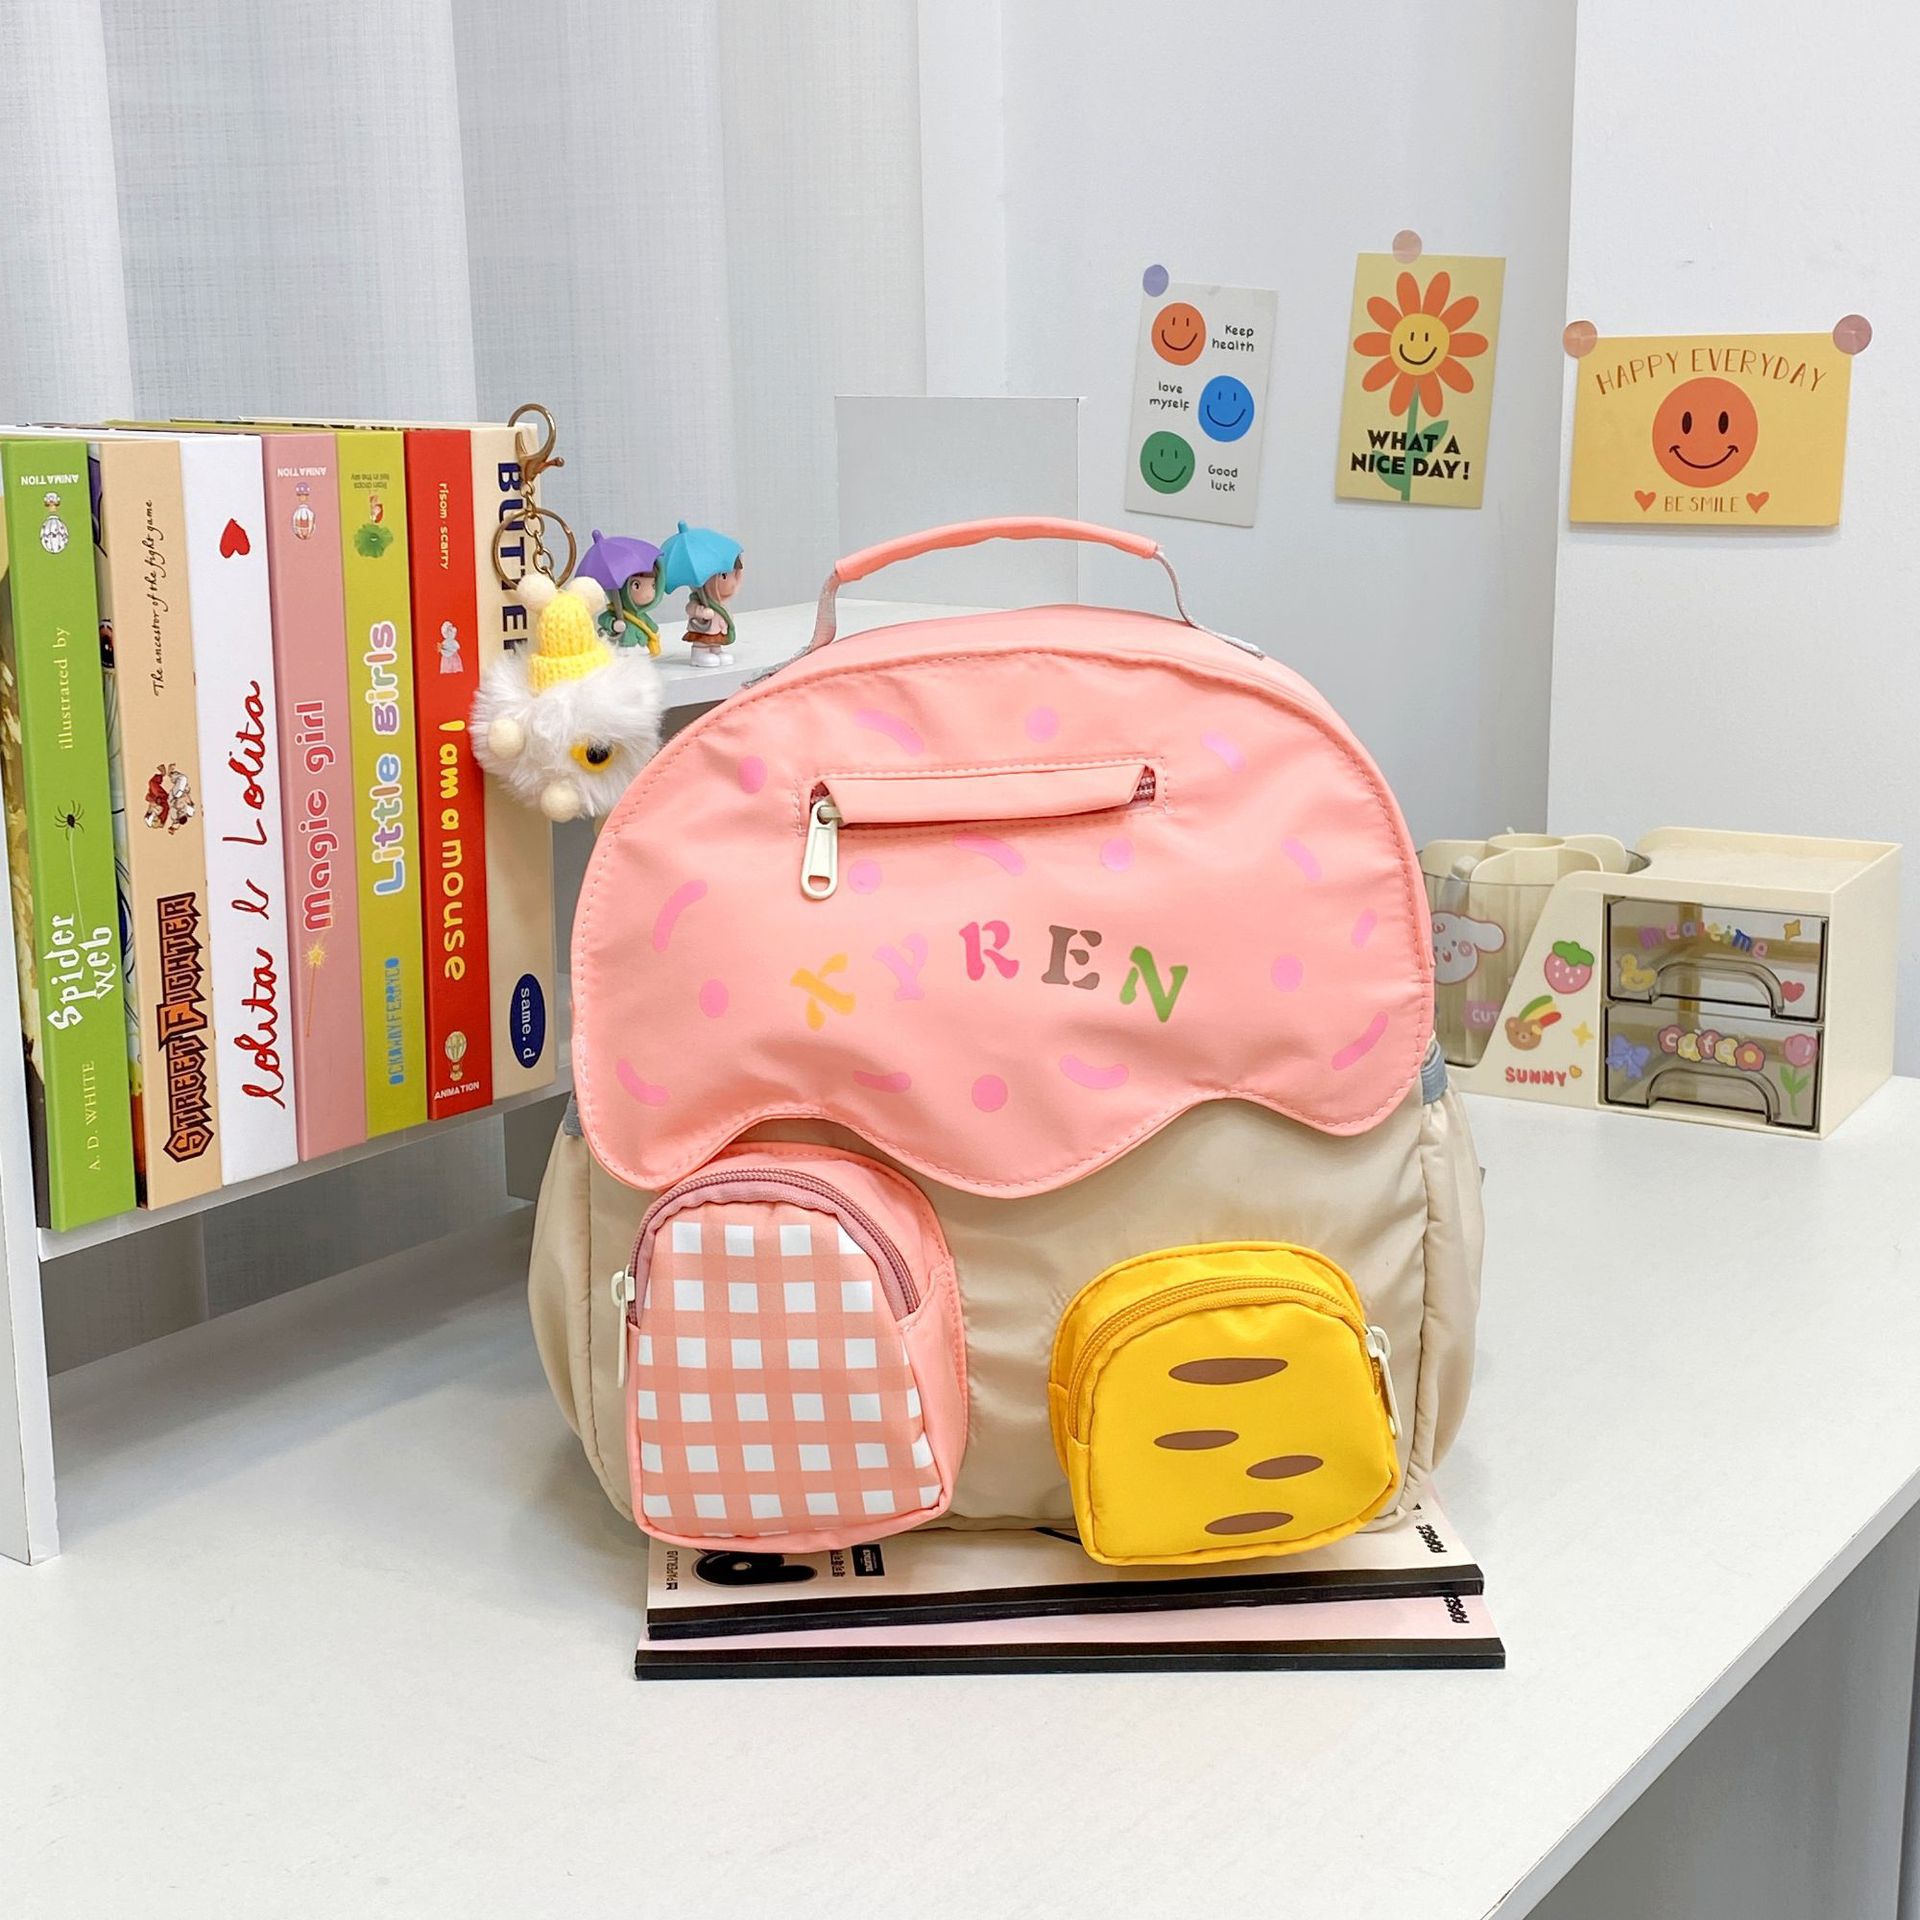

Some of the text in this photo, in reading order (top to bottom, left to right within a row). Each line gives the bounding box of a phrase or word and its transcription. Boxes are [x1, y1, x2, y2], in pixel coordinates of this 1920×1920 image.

[1225, 324, 1254, 338] Keep
[1212, 338, 1254, 352] health
[1596, 348, 1827, 395] HAPPY EVERYDAY
[1158, 381, 1183, 394] love
[1149, 397, 1190, 411] myself
[1367, 429, 1461, 455] WHAT A
[277, 466, 327, 478] ANIMATION
[1208, 464, 1238, 478] Good
[1350, 452, 1406, 475] NICE
[21, 474, 79, 487] ANIMATION
[1211, 480, 1235, 492] luck
[1664, 496, 1740, 513] BE SMILE
[438, 482, 450, 570] risom scarry
[142, 500, 168, 697] The ancestor of the fight game
[53, 627, 74, 751] illustrated by
[362, 620, 406, 897] Little girls
[294, 700, 339, 932] magic girl
[439, 720, 467, 982] I am a mouse
[43, 914, 101, 1030] Spider
[78, 925, 117, 1000] web
[789, 919, 1188, 1032] XYREN
[1505, 1065, 1567, 1087] SUNNY
[434, 1080, 480, 1101] ANIMATION
[81, 1060, 101, 1171] A. D. WHITE
